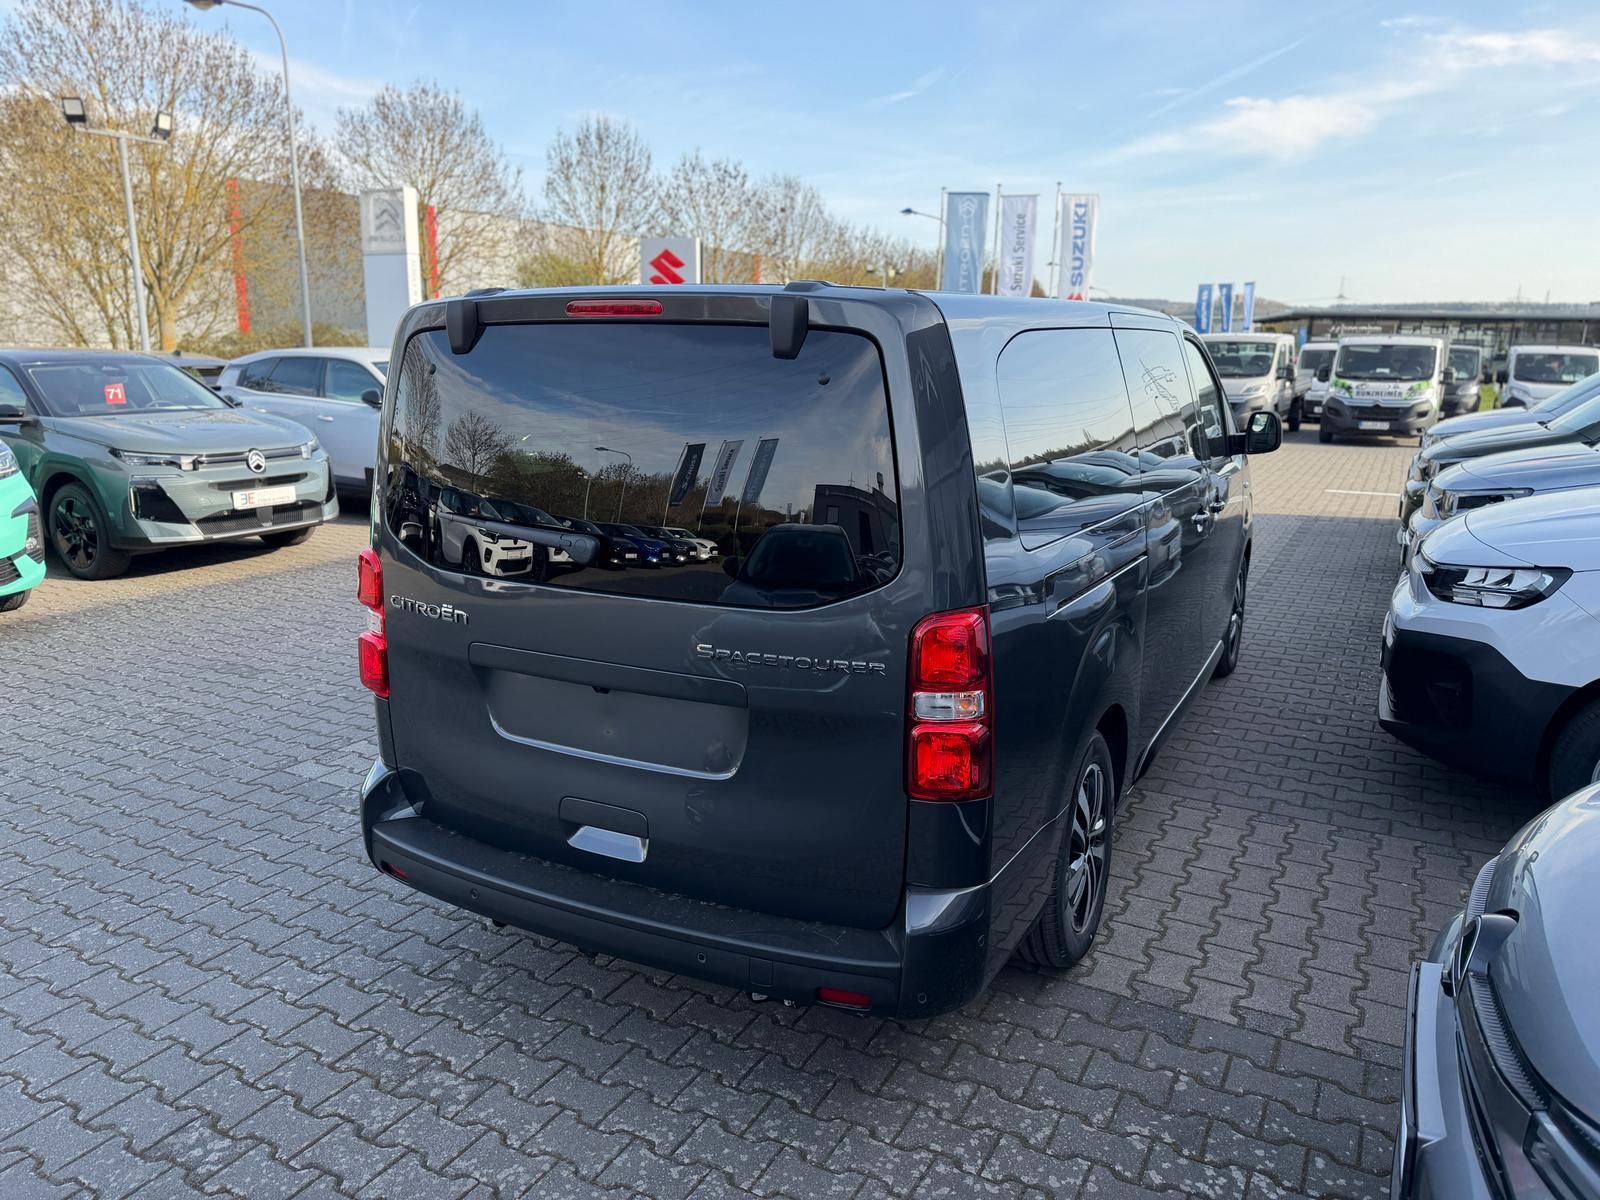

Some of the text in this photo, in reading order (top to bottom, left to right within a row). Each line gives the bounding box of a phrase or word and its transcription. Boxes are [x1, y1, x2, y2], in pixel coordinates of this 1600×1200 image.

[1010, 213, 1027, 292] Suzuki Service
[1070, 202, 1088, 288] SUZUKI
[105, 388, 122, 400] 71
